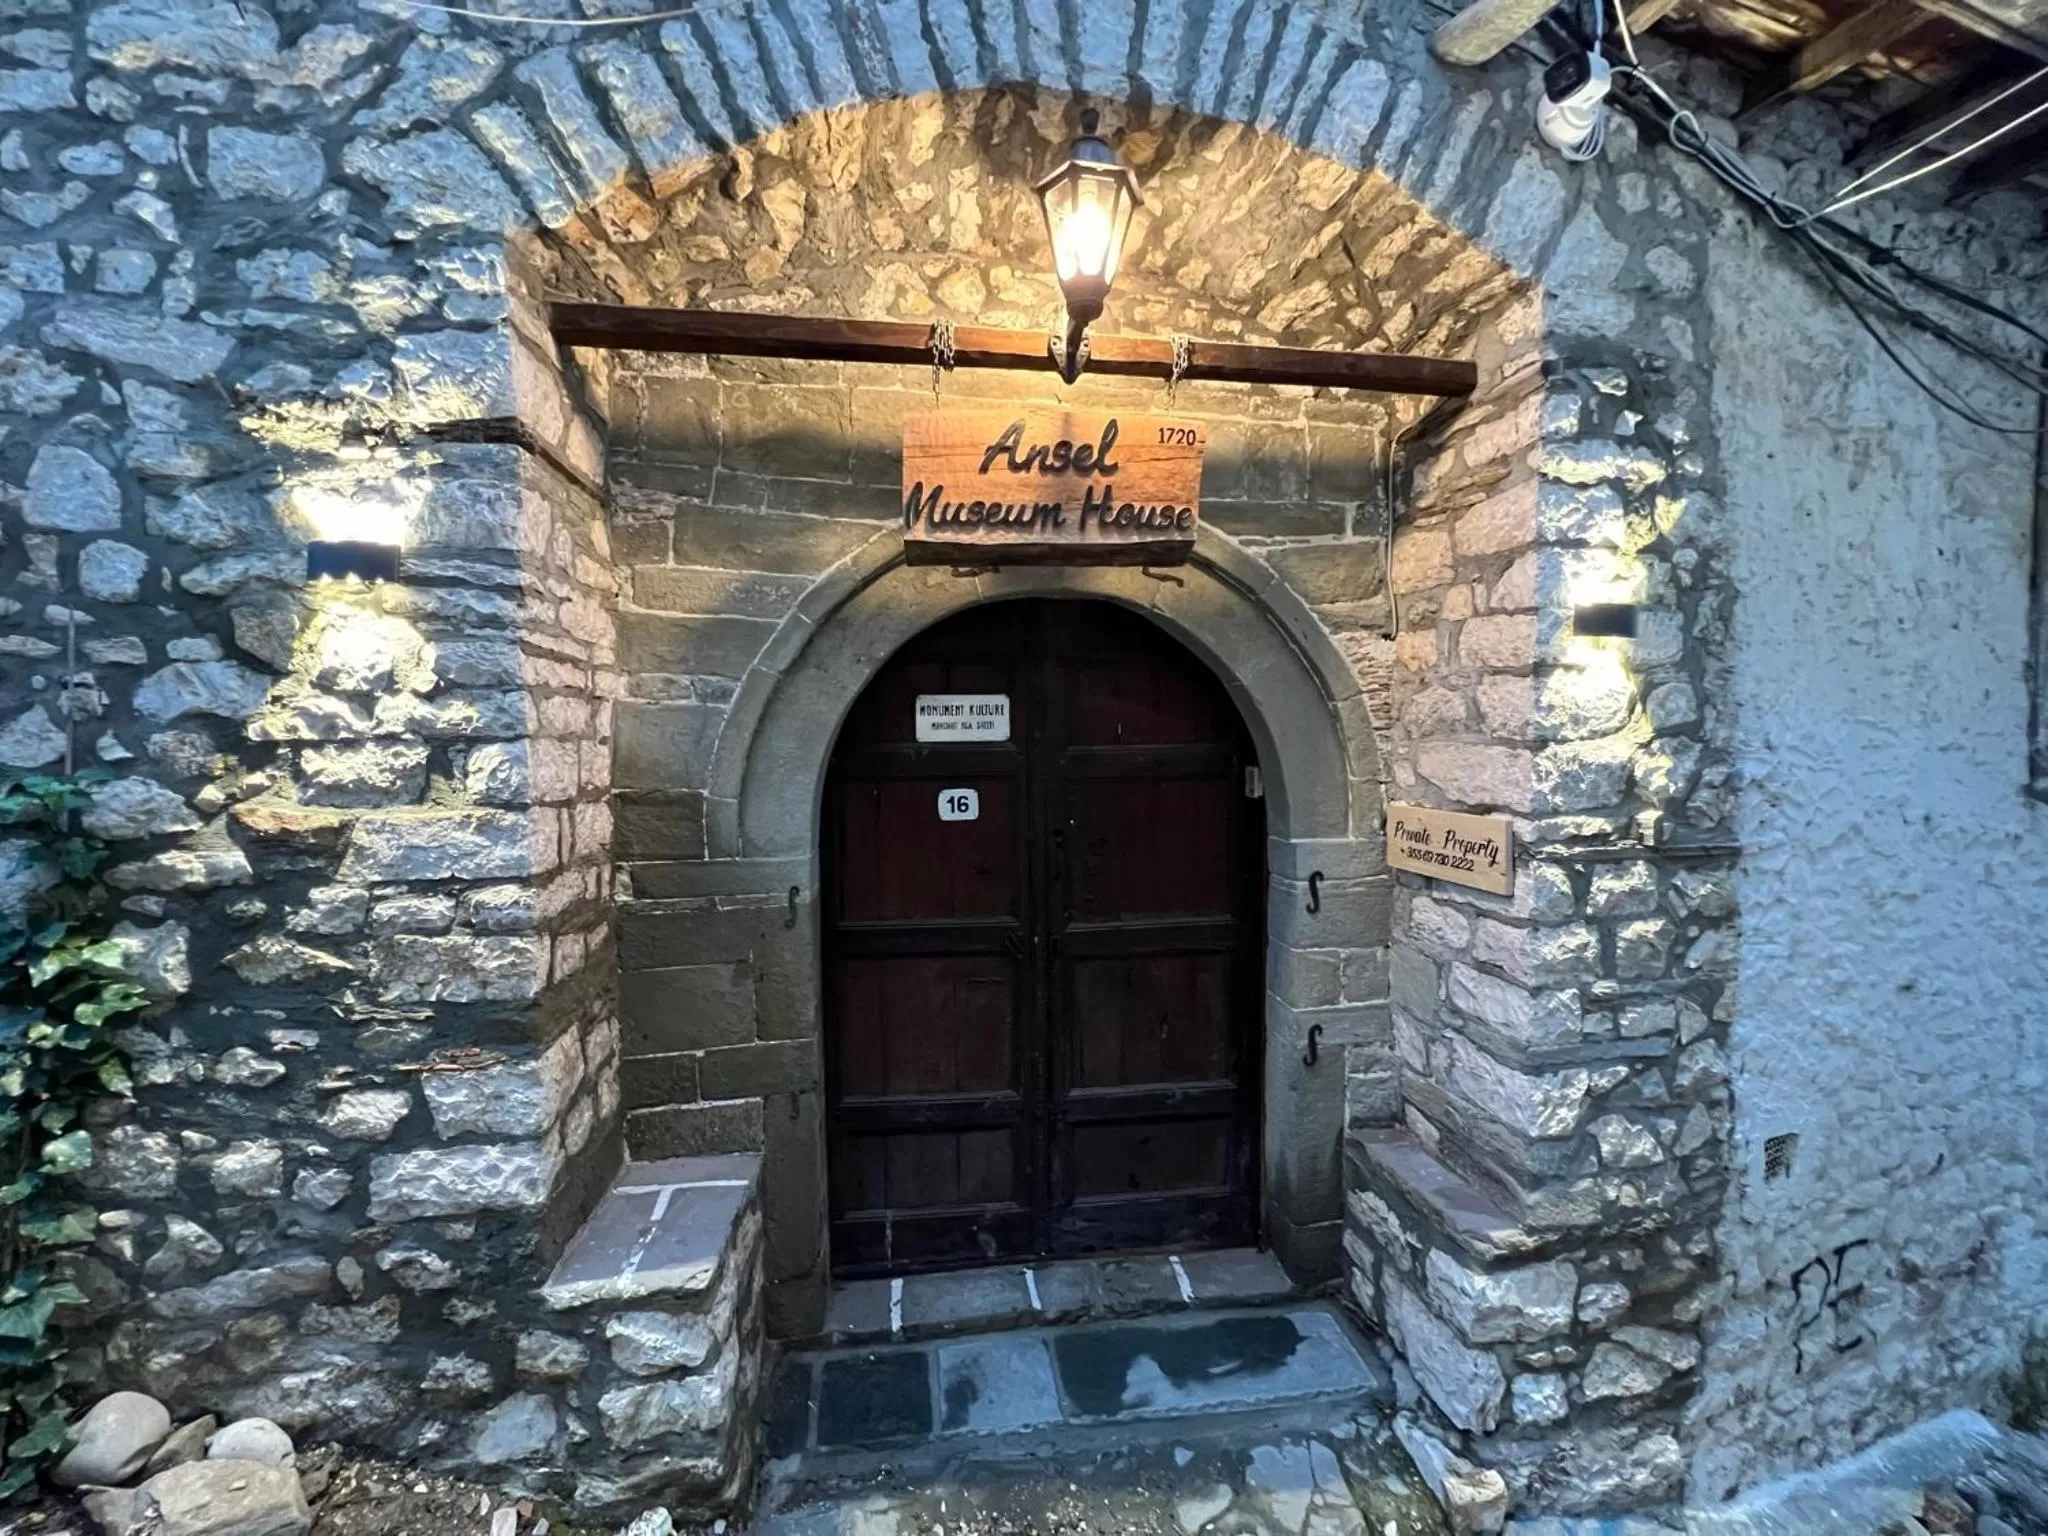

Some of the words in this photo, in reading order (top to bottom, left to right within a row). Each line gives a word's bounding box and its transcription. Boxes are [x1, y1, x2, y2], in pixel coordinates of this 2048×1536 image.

[978, 418, 1119, 476] Ansel
[1158, 427, 1197, 446] 1720
[905, 481, 1066, 530] Museum
[1080, 485, 1193, 532] House
[919, 704, 964, 716] MONUMENT
[946, 796, 970, 814] 16
[1394, 821, 1431, 845] Private
[1443, 830, 1499, 868] Property
